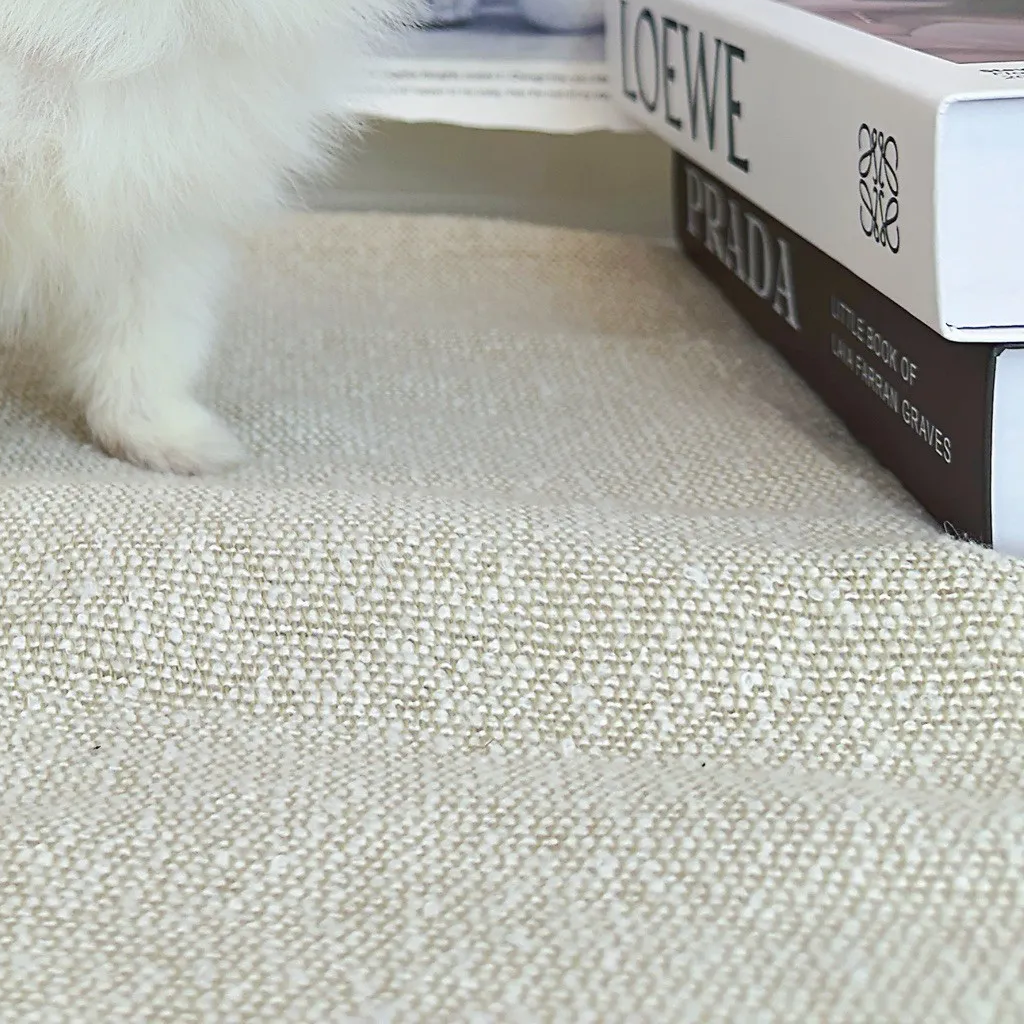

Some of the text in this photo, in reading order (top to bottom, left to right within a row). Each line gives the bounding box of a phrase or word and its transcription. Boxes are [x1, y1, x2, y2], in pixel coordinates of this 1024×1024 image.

[684, 165, 802, 332] PRADA
[866, 326, 898, 372] BOOK
[900, 356, 919, 386] OF
[901, 399, 952, 464] GRAVES
